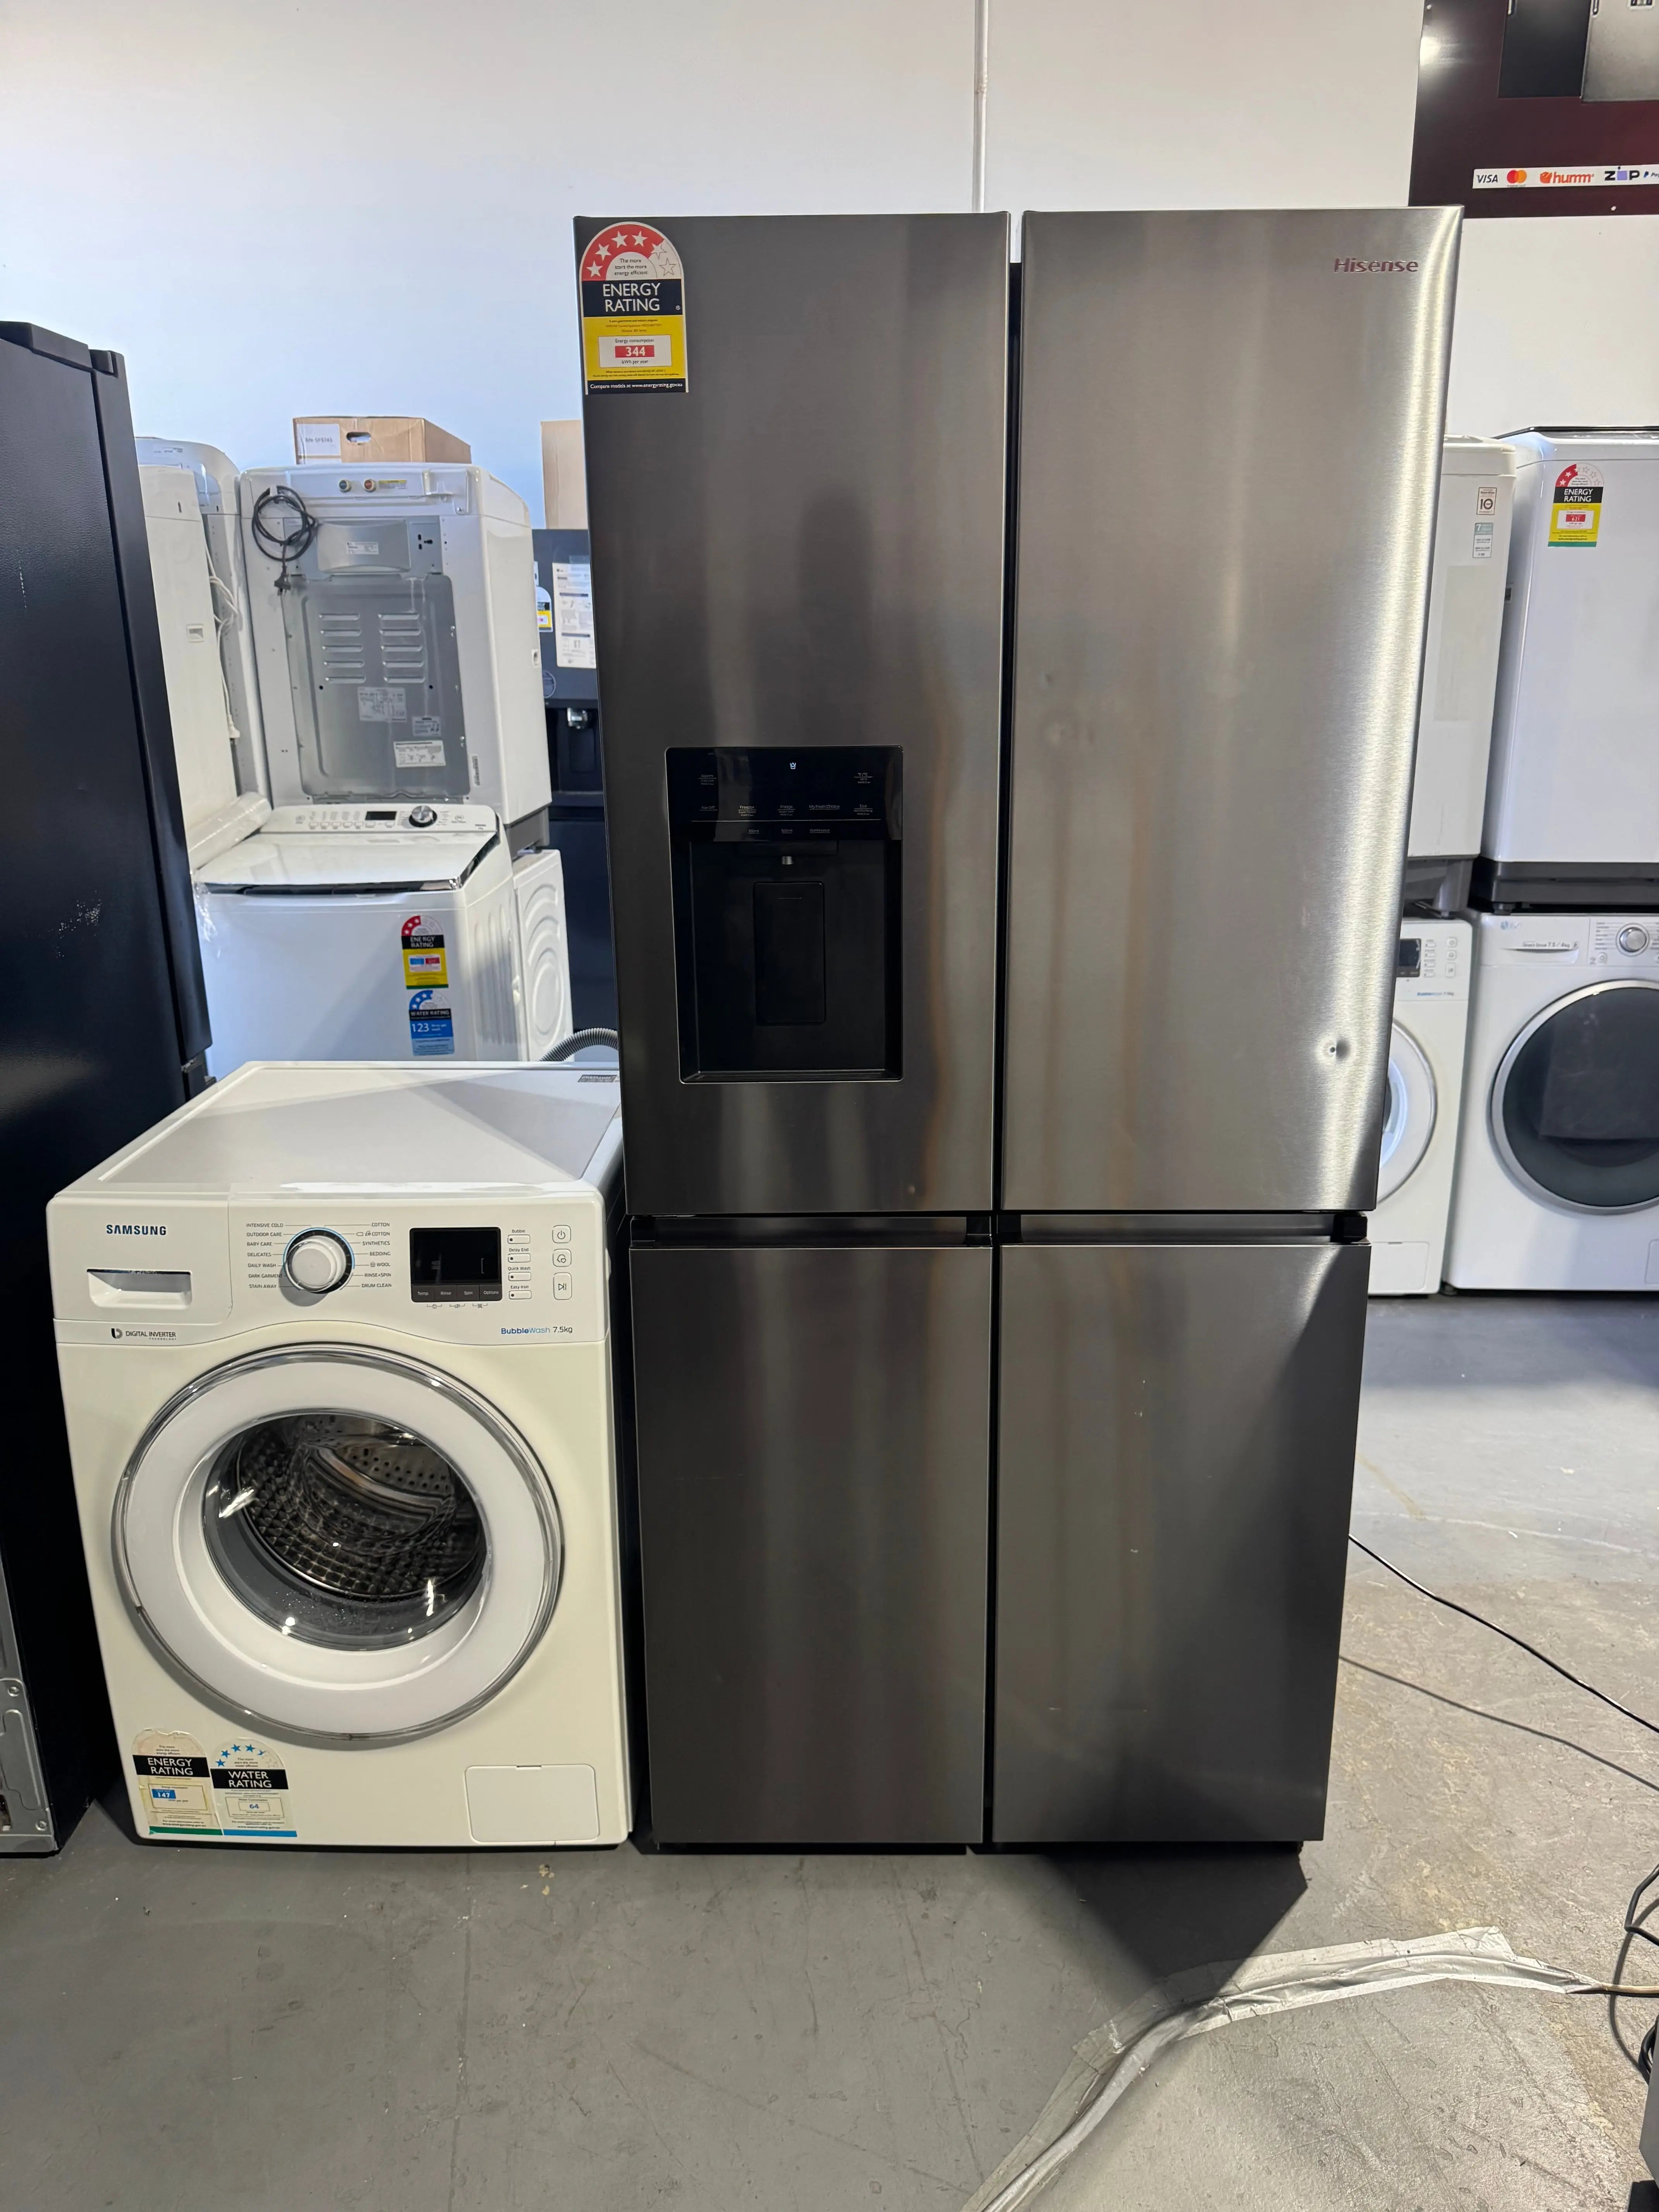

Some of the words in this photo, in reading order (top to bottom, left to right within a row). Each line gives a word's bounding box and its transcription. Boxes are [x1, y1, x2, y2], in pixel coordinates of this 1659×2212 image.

[1476, 174, 1498, 183] VISA
[1334, 258, 1419, 272] Hisense
[603, 283, 661, 297] ENERGY
[605, 298, 660, 312] RATING
[625, 346, 646, 357] 344
[412, 1023, 429, 1032] 123
[106, 1224, 167, 1235] SAMSUNG
[147, 1757, 192, 1766] ENERGY
[150, 1766, 194, 1776] RATING
[228, 1771, 269, 1779] WATER
[228, 1779, 272, 1788] RATING
